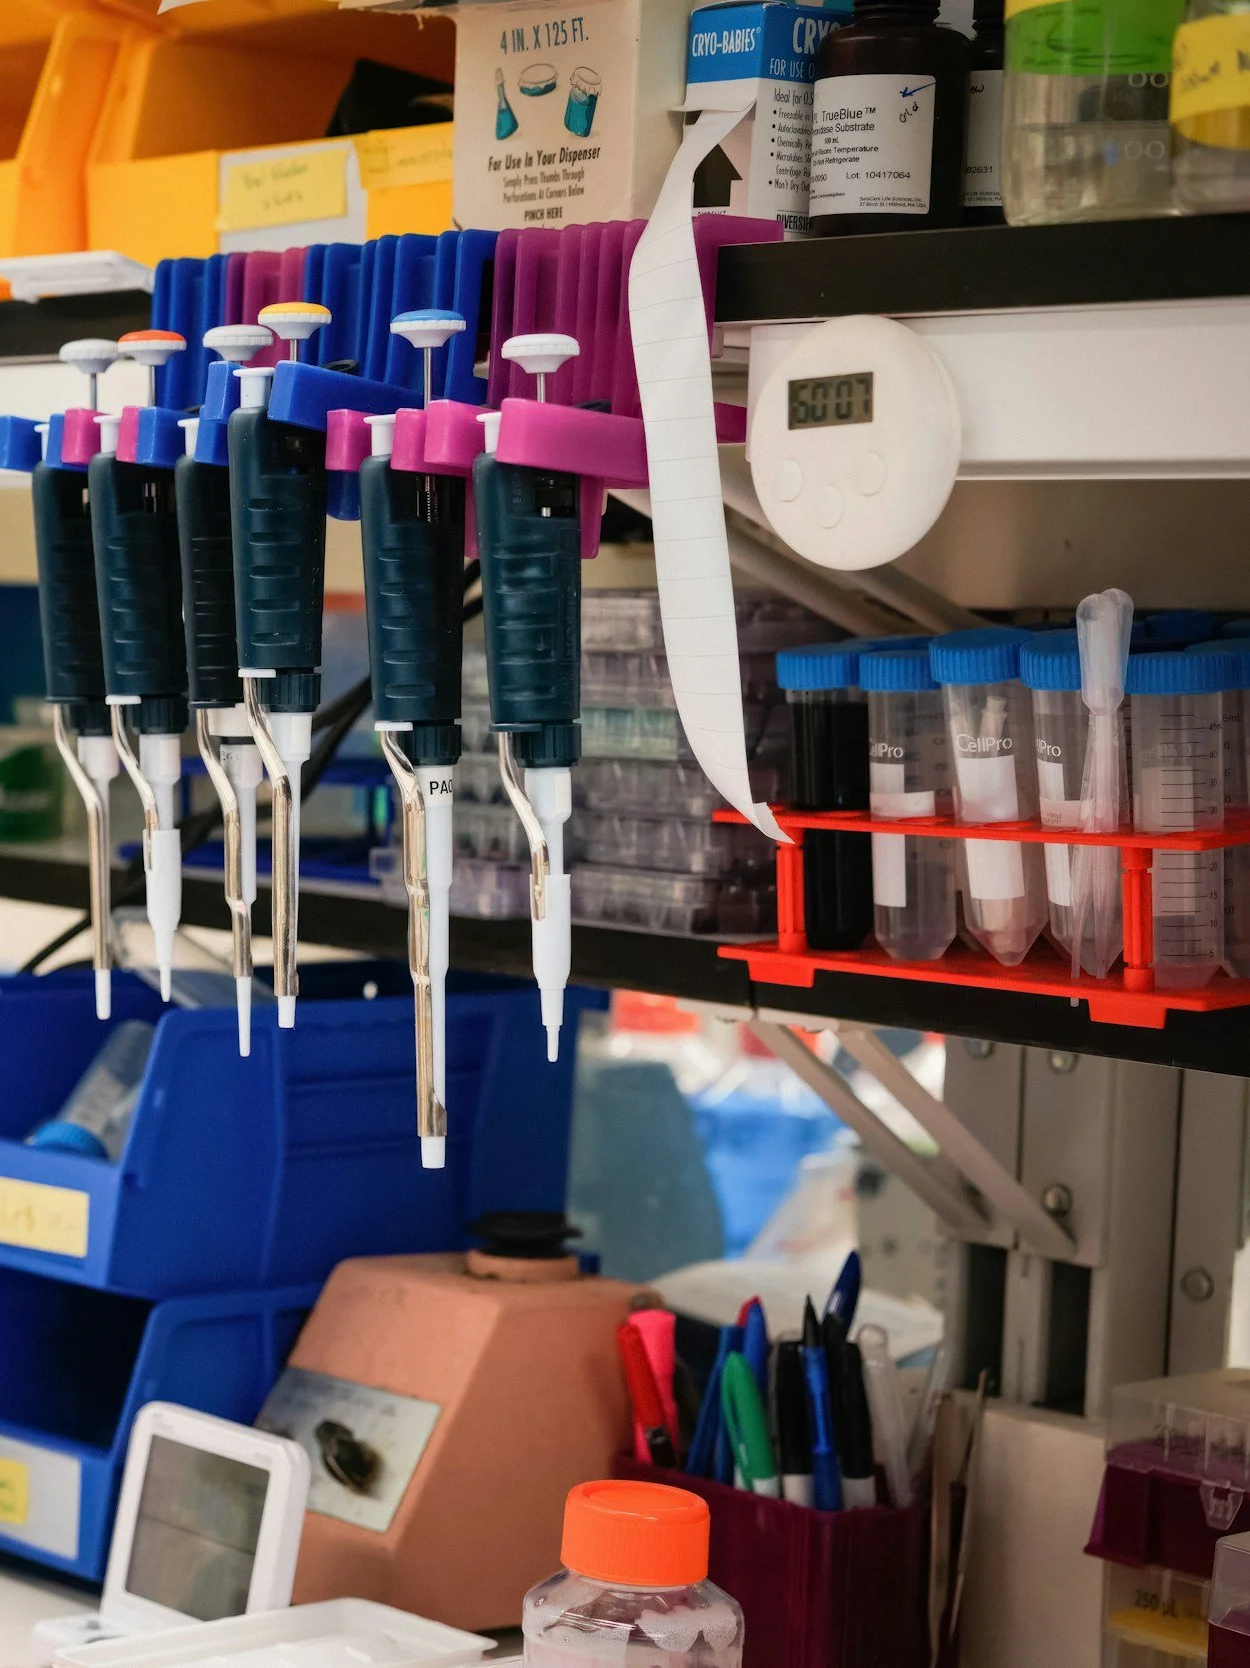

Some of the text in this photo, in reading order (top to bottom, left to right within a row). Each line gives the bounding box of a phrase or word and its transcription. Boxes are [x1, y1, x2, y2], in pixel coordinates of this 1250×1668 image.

[500, 17, 589, 55] 4 IN. X 125 FT.
[769, 57, 786, 76] FOR
[790, 61, 804, 79] USE
[774, 88, 790, 104] Ideal
[793, 89, 802, 105] for
[778, 108, 803, 121] Freezable
[835, 123, 875, 132] Substrate
[834, 145, 879, 155] Temperature
[488, 147, 601, 172] For Use In Your Dispenser
[826, 156, 860, 165] Refrigerate
[562, 167, 585, 182] Through
[776, 164, 802, 178] Centrifuge
[865, 171, 911, 179] 10417064
[568, 184, 584, 197] Below
[524, 206, 563, 222] PINCH HERE
[957, 734, 1012, 752] CellPro
